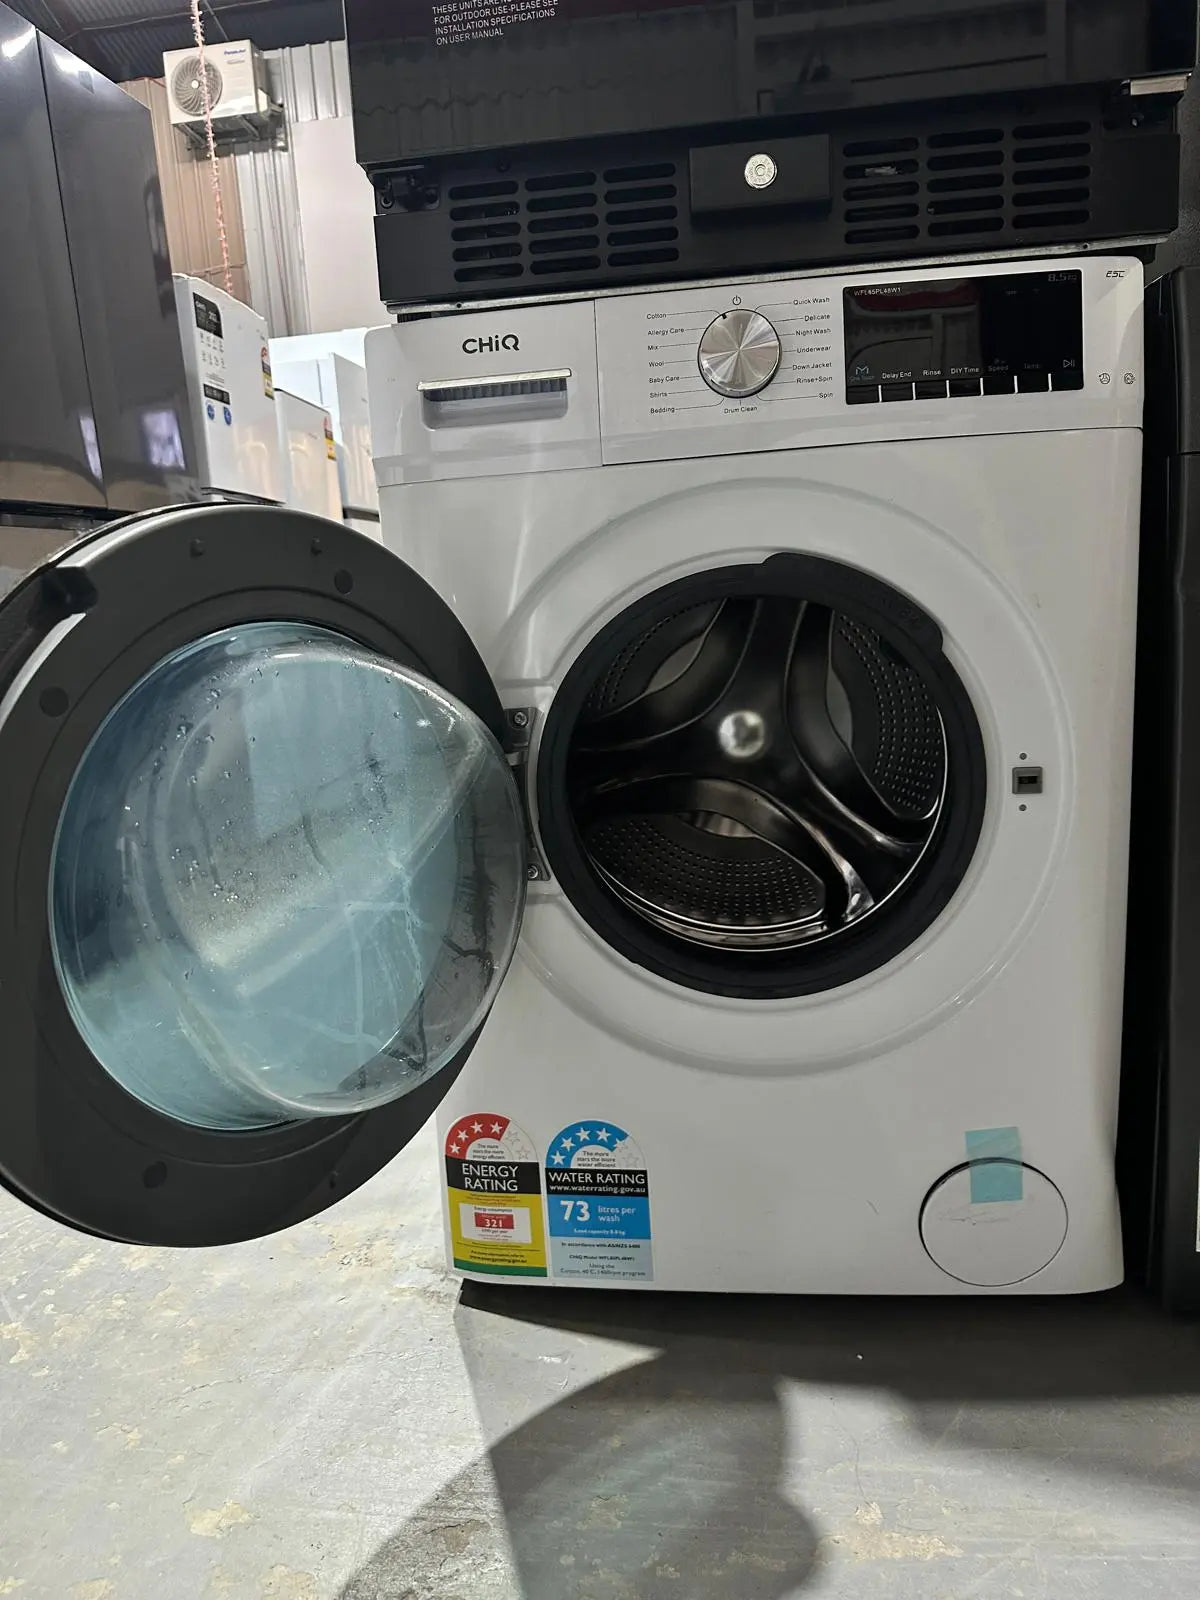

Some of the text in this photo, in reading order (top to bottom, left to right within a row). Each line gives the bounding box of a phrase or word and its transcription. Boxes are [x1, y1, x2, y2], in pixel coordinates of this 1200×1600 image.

[432, 3, 457, 15] THESE
[460, 0, 483, 10] UNITS
[434, 15, 450, 24] FOR
[452, 8, 490, 22] OUTDOOR
[493, 1, 540, 16] USE-PLEASE
[436, 8, 556, 35] INSTALLATION SPECIFICATIONS
[436, 28, 504, 46] ON USER MANUAL
[988, 364, 1009, 372] Speed
[462, 1163, 518, 1178] ENERGY
[464, 1177, 518, 1191] RATING
[548, 1172, 646, 1184] WATER RATING
[549, 1185, 646, 1194] www.waterrating.gov.au
[560, 1200, 590, 1222] 73
[598, 1205, 637, 1215] litres per
[484, 1218, 503, 1228] 321
